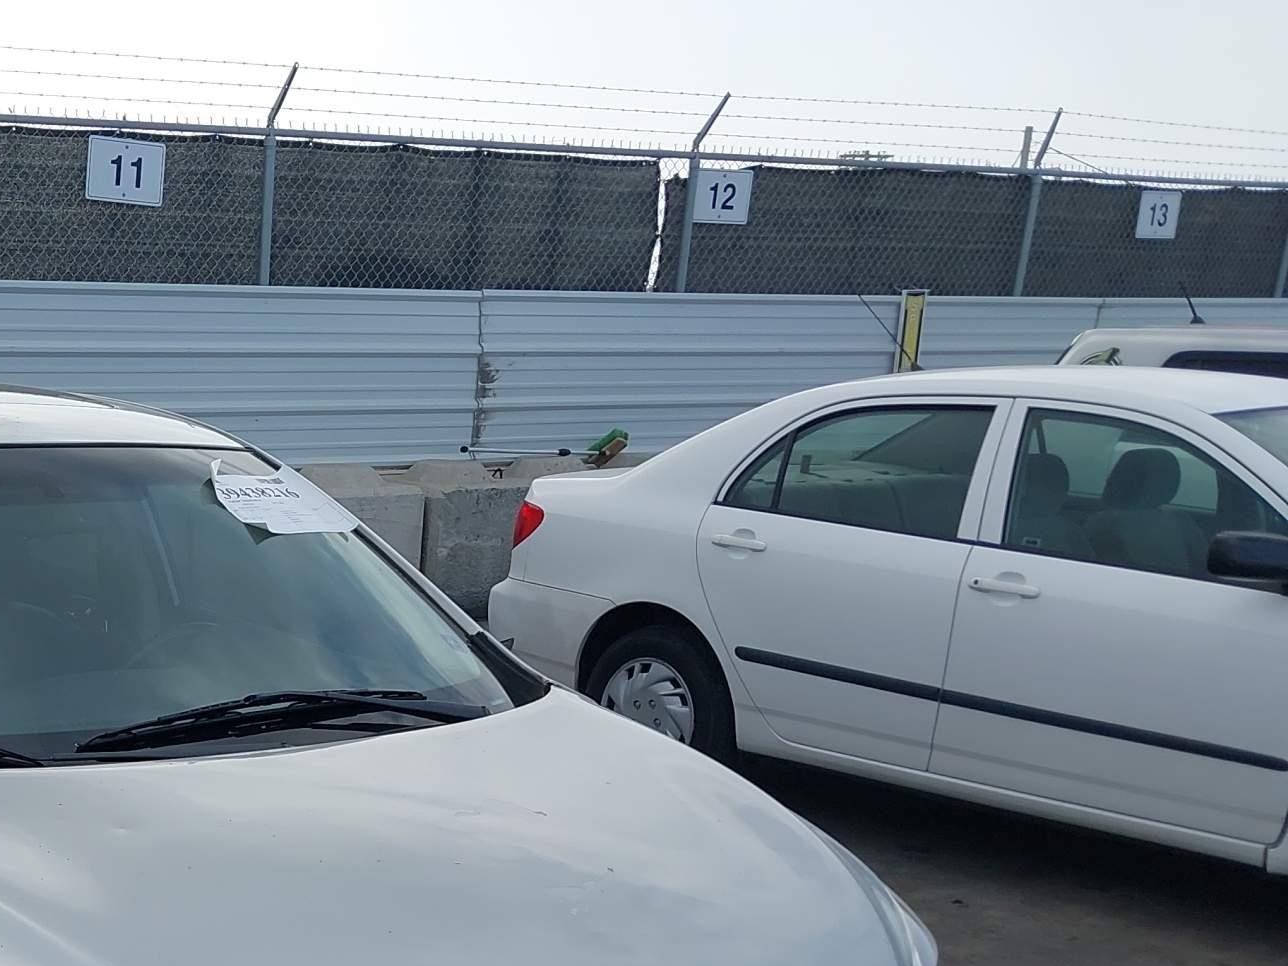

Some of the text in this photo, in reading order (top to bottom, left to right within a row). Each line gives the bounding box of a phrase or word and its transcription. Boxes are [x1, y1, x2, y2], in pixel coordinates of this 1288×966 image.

[111, 155, 142, 188] 11
[710, 182, 736, 210] 12
[1150, 203, 1168, 227] 13
[216, 487, 301, 500] 39438216
